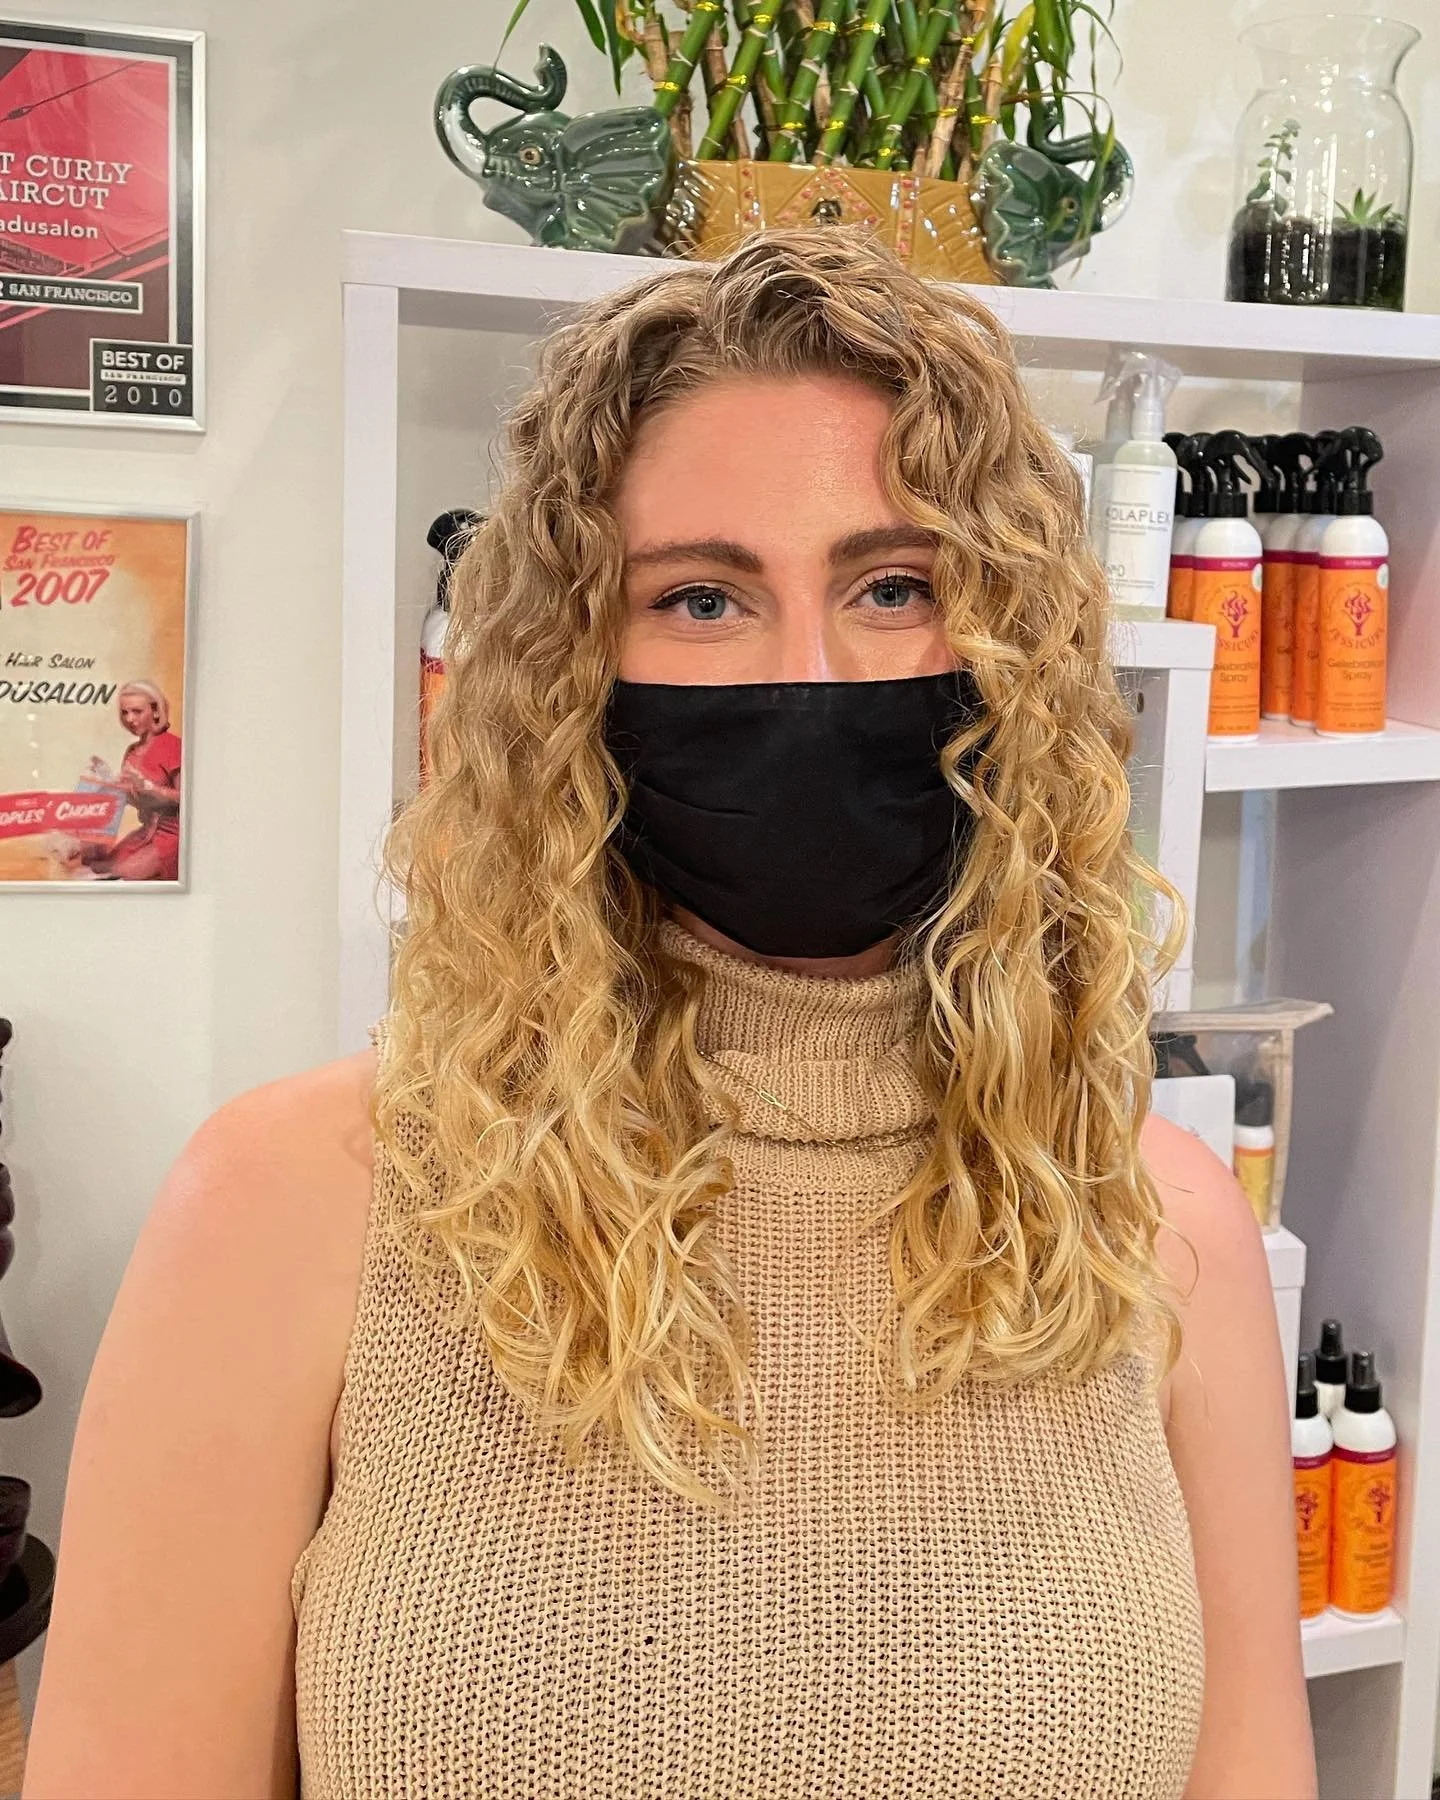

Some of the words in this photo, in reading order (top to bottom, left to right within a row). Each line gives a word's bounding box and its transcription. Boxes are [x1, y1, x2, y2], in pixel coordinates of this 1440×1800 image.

[26, 154, 133, 184] CURLY
[9, 283, 41, 298] SAN
[44, 285, 133, 304] FRANCISCO
[102, 350, 152, 369] BEST
[156, 353, 185, 371] OF
[12, 525, 79, 553] BEST
[82, 529, 113, 551] OF
[11, 568, 111, 608] 2007
[48, 653, 95, 669] SALON
[55, 801, 111, 821] CHOICE
